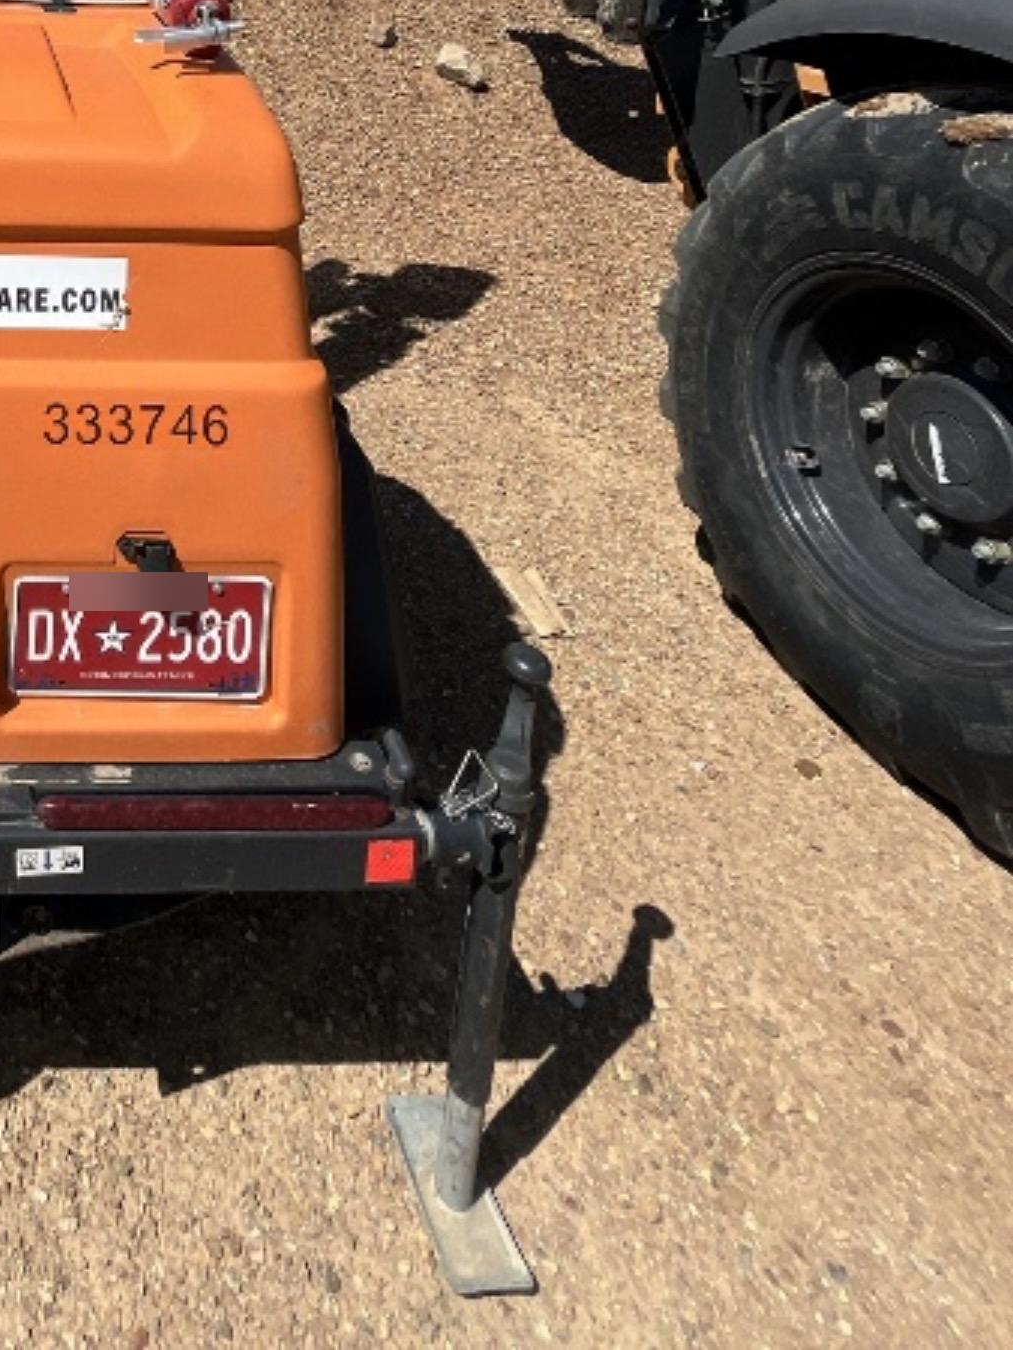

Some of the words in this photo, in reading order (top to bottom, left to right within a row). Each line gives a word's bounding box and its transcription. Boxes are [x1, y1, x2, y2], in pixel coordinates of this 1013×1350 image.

[43, 403, 230, 446] 333746
[26, 607, 85, 664] DX
[136, 607, 253, 664] 2580
